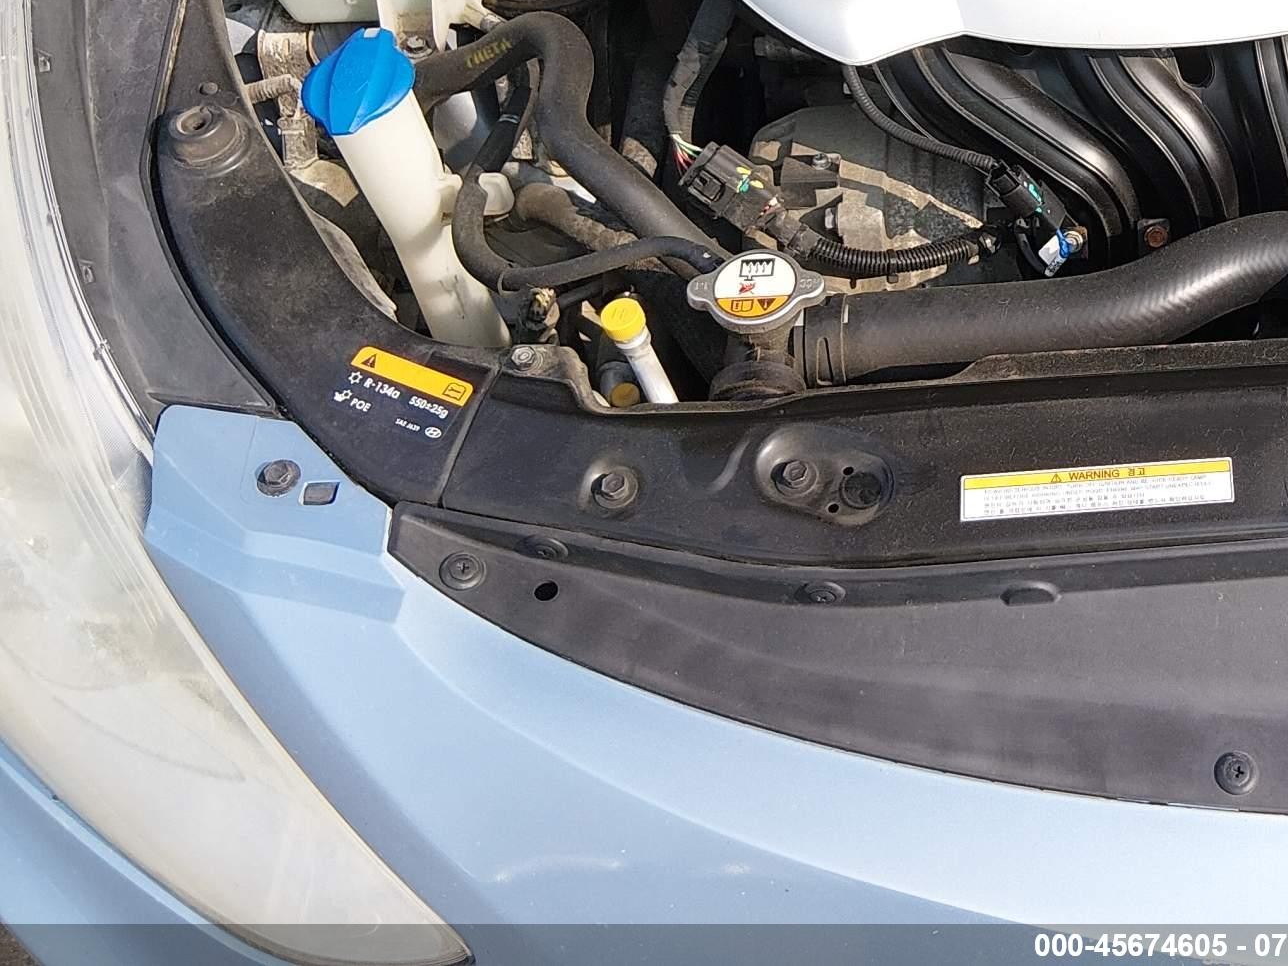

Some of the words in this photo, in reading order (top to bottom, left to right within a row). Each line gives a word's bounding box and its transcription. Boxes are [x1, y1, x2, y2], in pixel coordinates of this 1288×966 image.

[350, 397, 372, 412] POE
[363, 377, 401, 399] R-134a
[408, 395, 449, 419] 550±25g
[1068, 469, 1120, 481] WARNING
